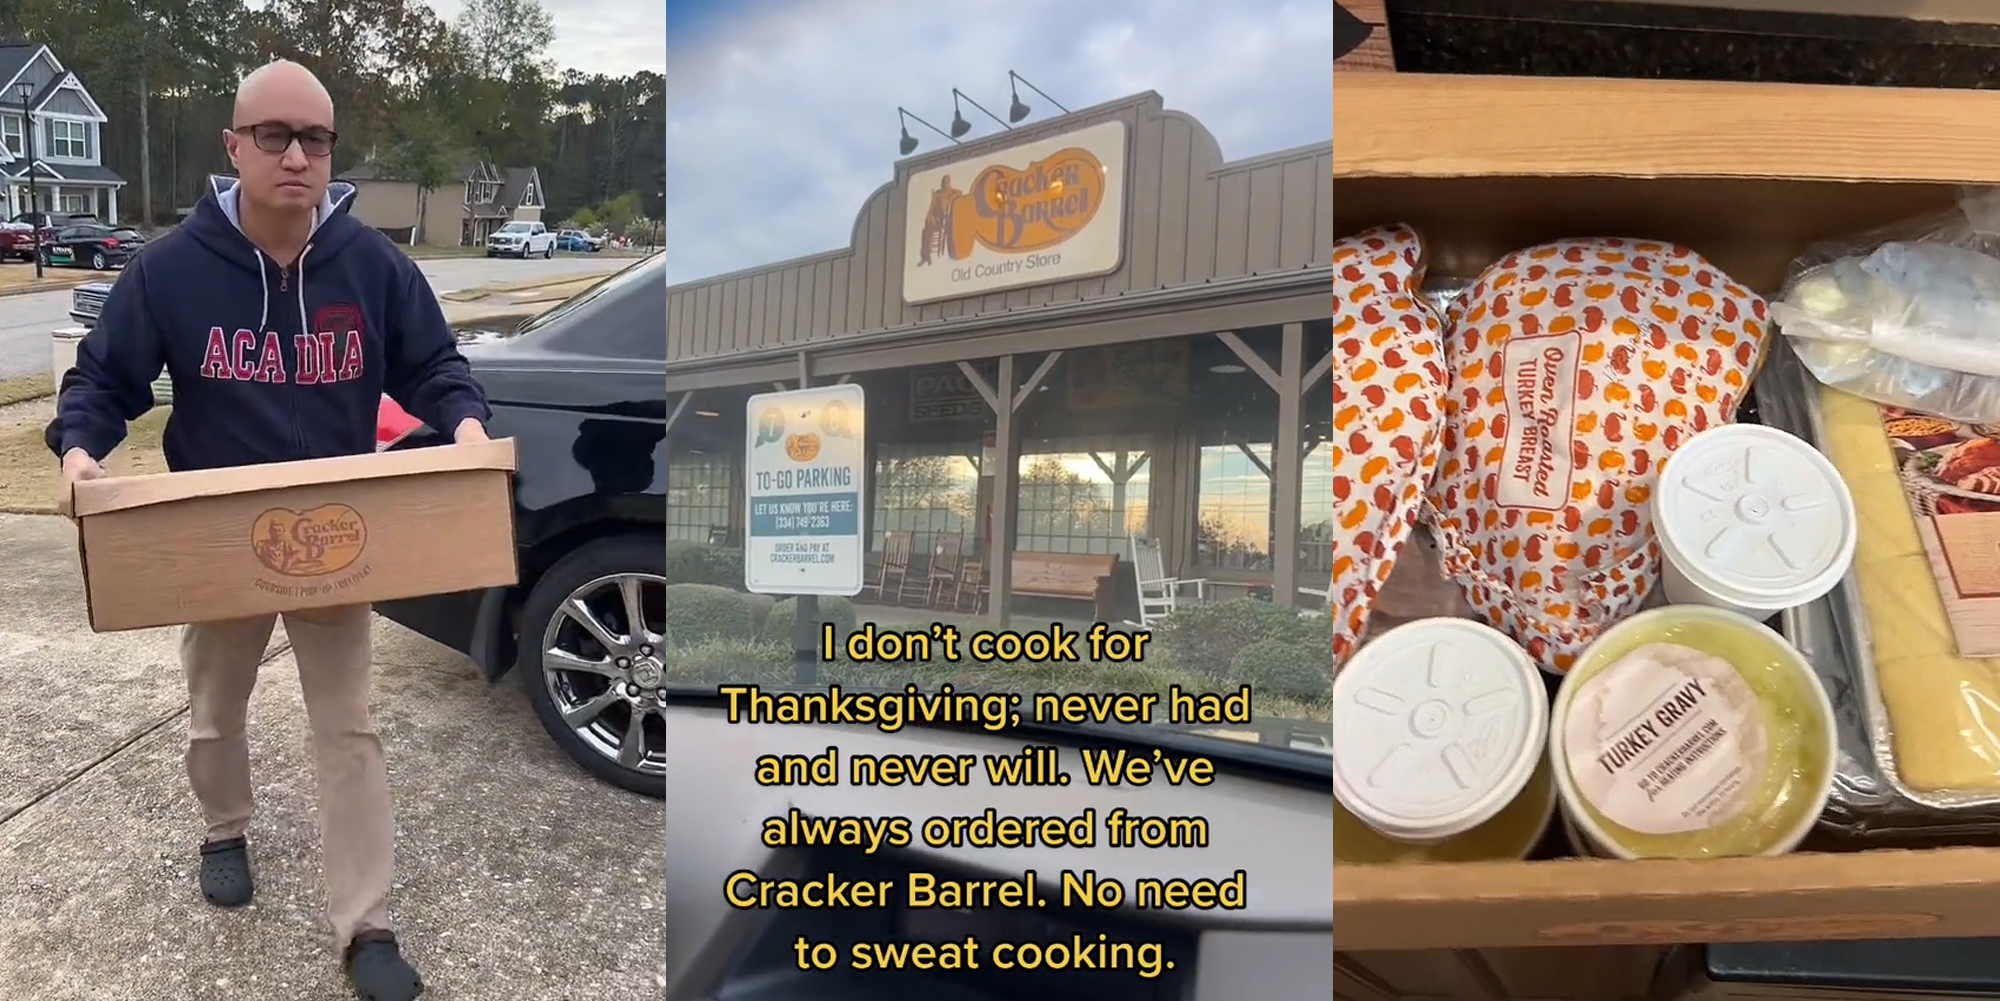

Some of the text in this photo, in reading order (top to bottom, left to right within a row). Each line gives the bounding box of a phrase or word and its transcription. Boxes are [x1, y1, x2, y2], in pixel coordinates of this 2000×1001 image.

[974, 164, 1080, 218] Cracker
[996, 188, 1089, 248] Barrel
[951, 253, 1062, 283] Old Country Store
[200, 326, 364, 384] ACADIA
[913, 401, 983, 420] SEEDS
[1512, 357, 1539, 483] TURKEY BREAST
[1532, 347, 1564, 498] Oven Roasted
[756, 466, 851, 490] TO-GO PARKING
[754, 500, 853, 515] LET US KNOW YOU'RE HERE:
[775, 515, 794, 530] (334)
[291, 518, 358, 545] Cracker
[304, 529, 359, 559] Barrel
[769, 553, 835, 564] CRACKERBARREL.COM
[774, 542, 830, 553] ORDER AND PAY AT
[1596, 677, 1708, 775] TURKEY GRAVY
